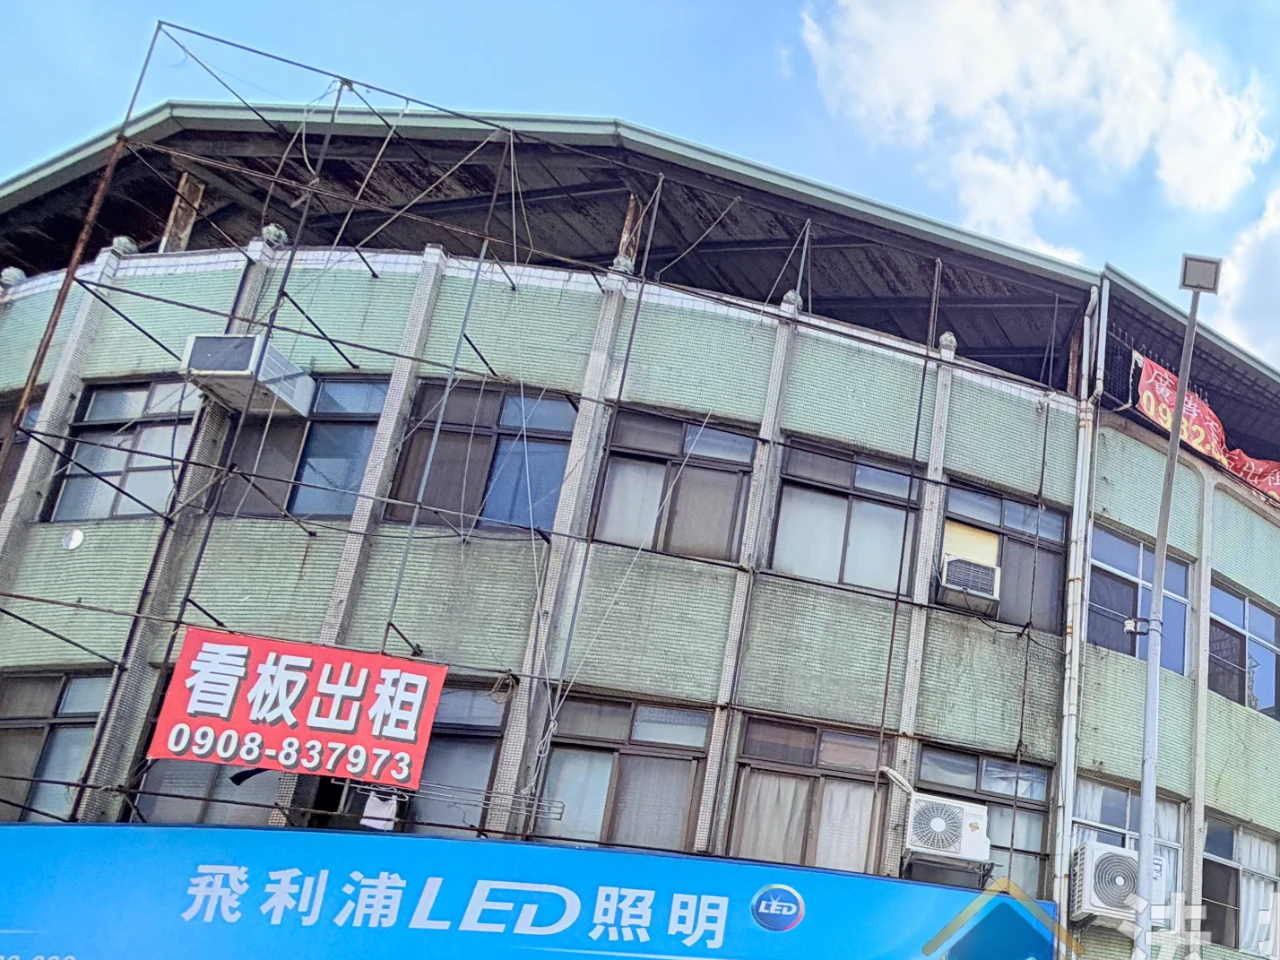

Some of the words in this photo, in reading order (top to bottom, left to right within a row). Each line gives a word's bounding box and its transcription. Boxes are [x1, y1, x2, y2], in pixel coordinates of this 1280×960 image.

[185, 642, 429, 742] 看板出租
[167, 723, 412, 782] 0908-837973
[181, 865, 729, 949] 飛利浦LED照明
[758, 899, 798, 917] LED
